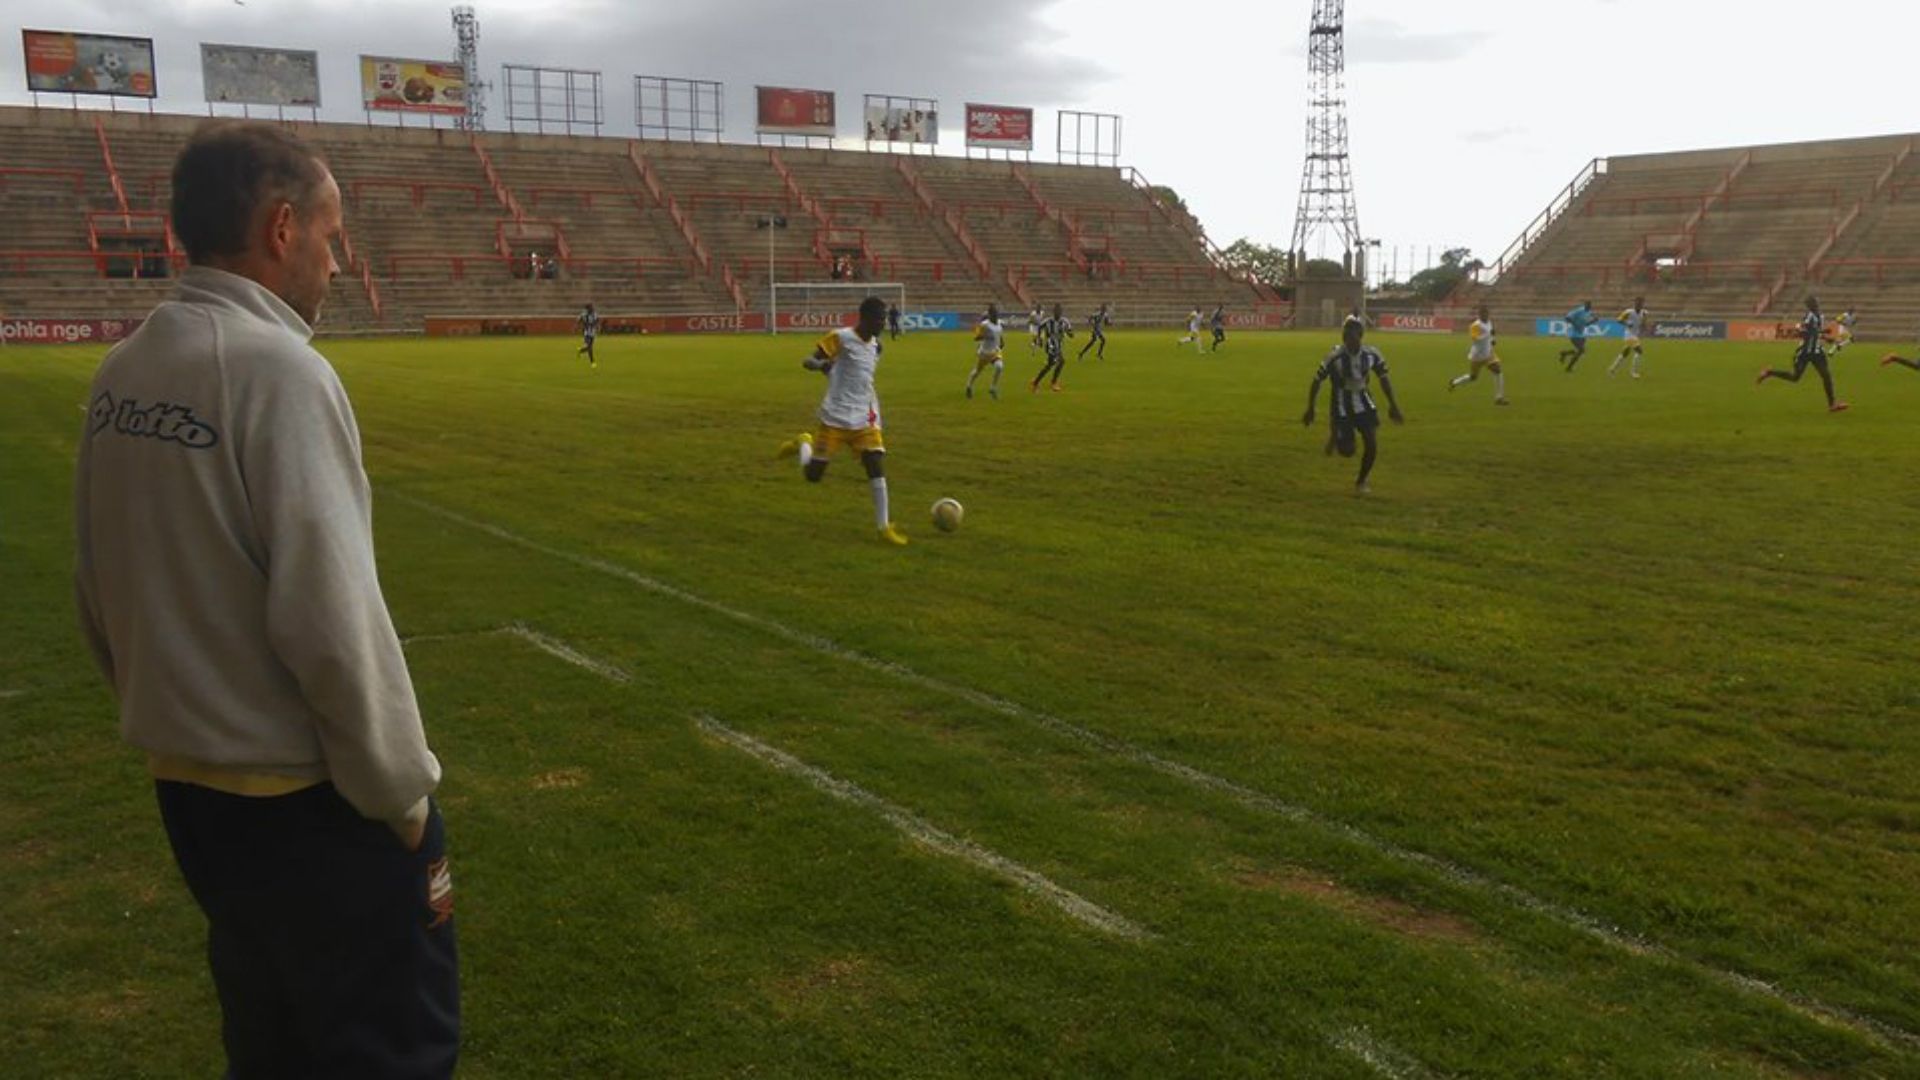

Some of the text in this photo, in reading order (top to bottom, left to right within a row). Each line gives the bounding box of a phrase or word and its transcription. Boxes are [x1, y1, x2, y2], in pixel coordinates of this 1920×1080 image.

[687, 315, 745, 330] CASTLE
[790, 313, 844, 327] CASTLE
[1229, 314, 1267, 325] CASTLE
[1394, 316, 1436, 328] CASTLE
[53, 323, 92, 341] nge
[115, 398, 218, 449] lotto
